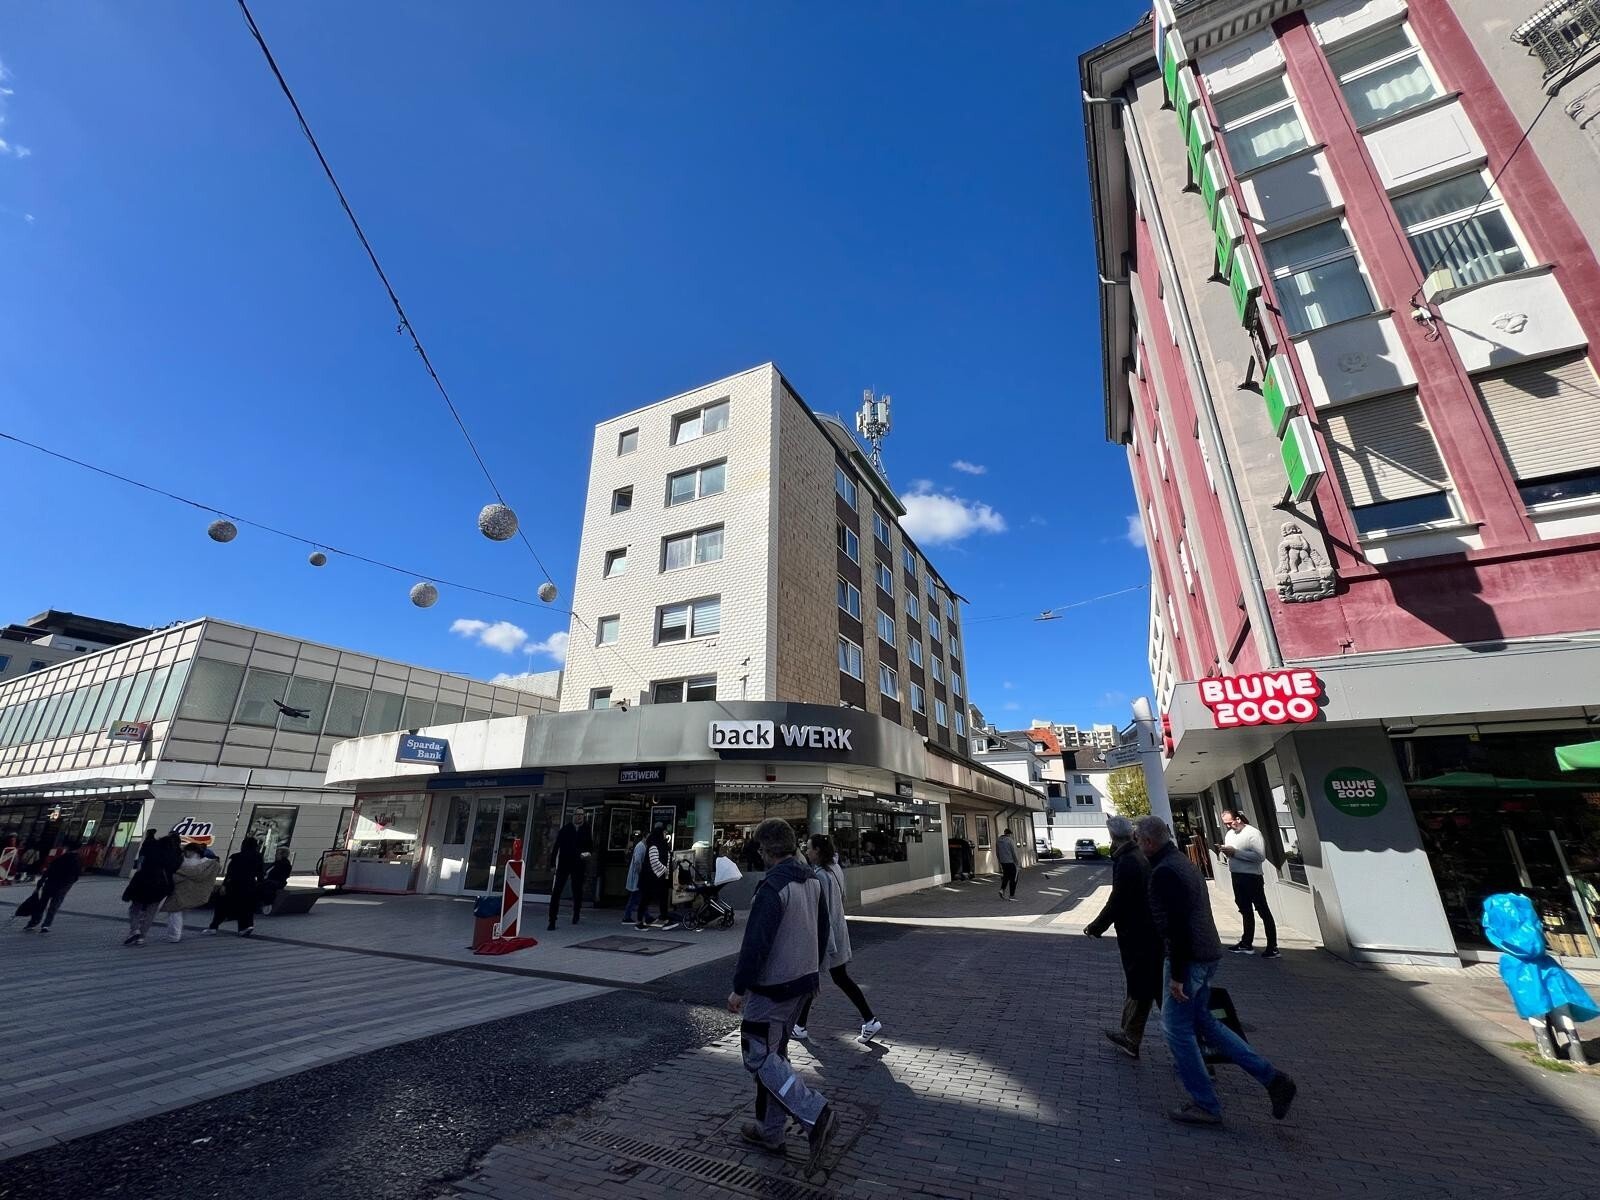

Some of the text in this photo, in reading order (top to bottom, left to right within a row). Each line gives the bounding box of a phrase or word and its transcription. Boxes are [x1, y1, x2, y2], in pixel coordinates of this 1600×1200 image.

[1202, 672, 1316, 702] BLUME
[1216, 697, 1313, 723] 2000
[120, 725, 138, 733] dm
[712, 723, 852, 750] back WERK
[407, 740, 444, 750] Sparda-
[417, 750, 441, 759] Bank
[638, 770, 660, 779] WERK
[1332, 780, 1376, 789] BLUME
[1338, 789, 1375, 798] 2000
[175, 818, 211, 835] dm
